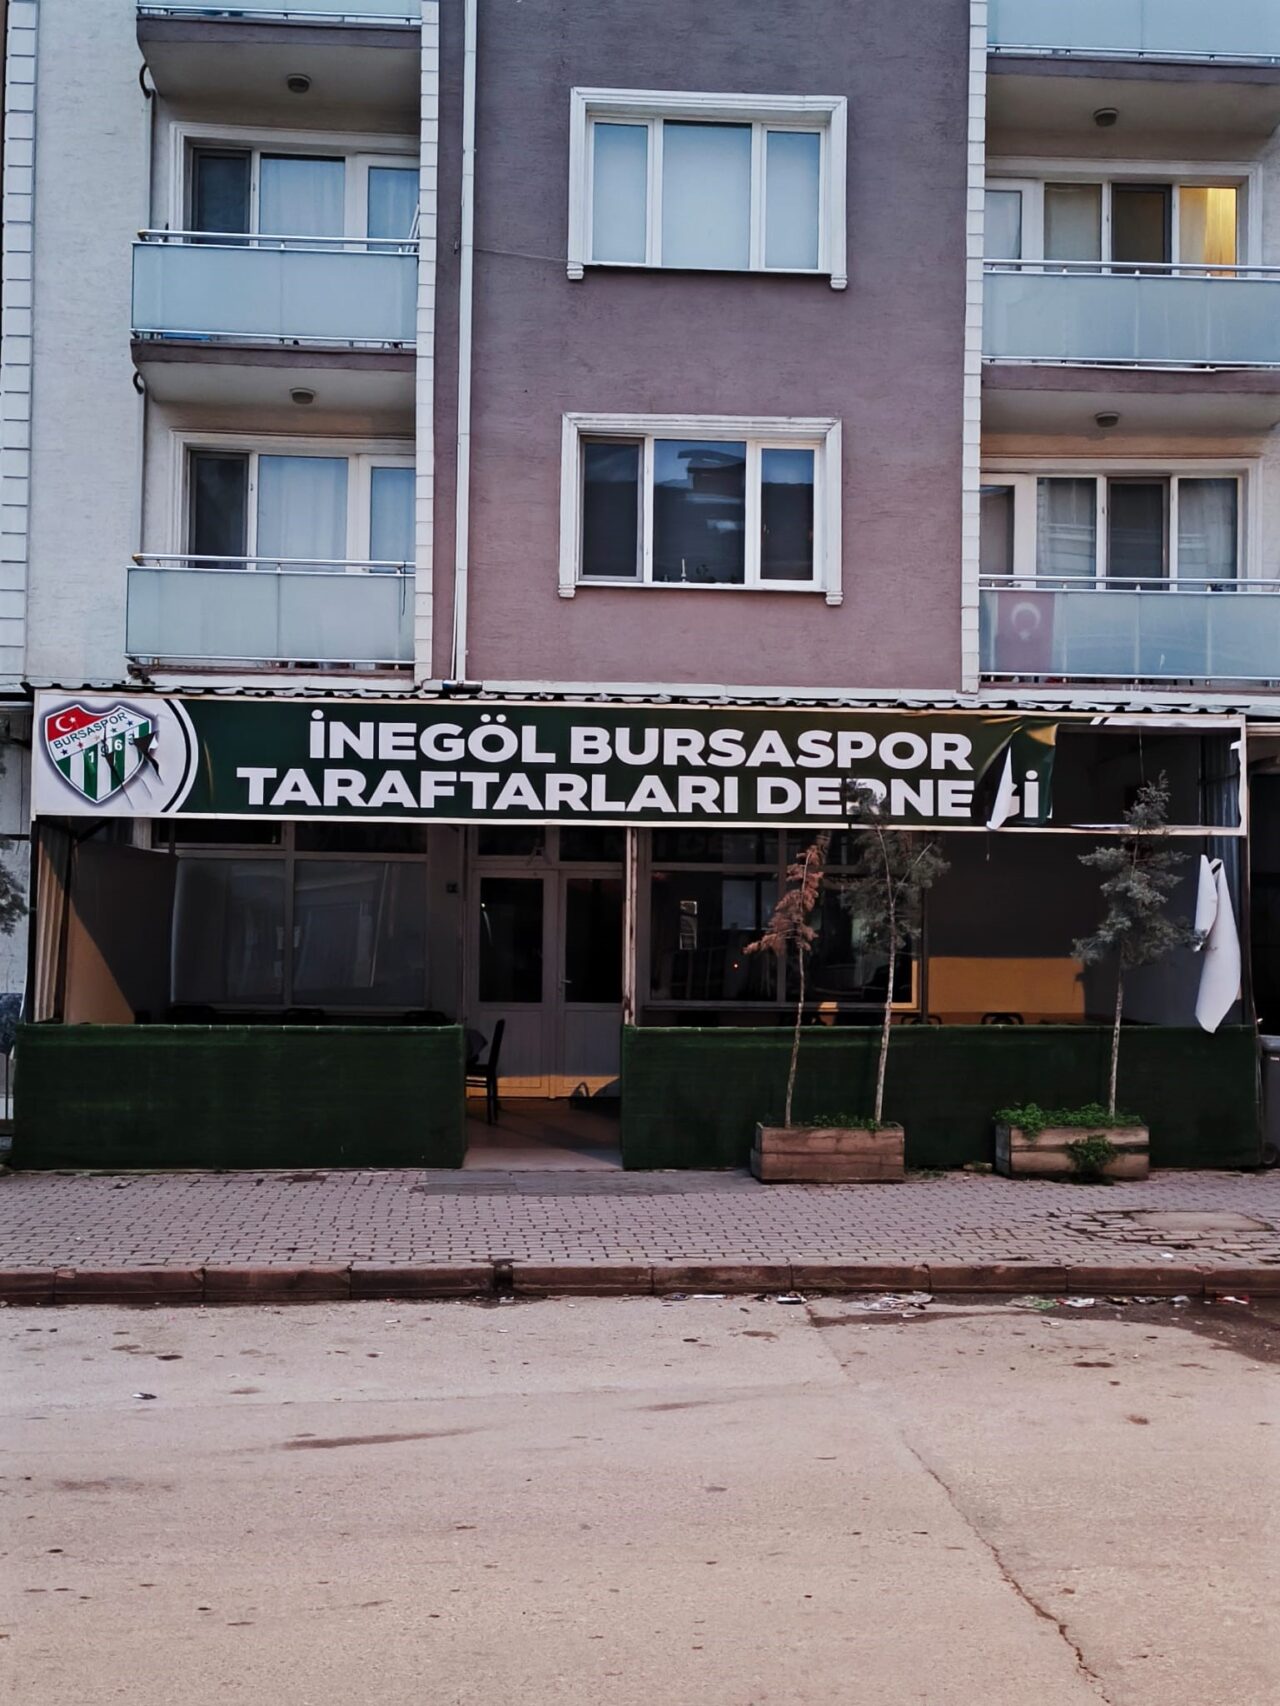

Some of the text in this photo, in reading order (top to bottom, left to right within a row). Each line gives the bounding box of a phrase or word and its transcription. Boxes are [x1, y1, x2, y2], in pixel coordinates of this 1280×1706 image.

[53, 711, 127, 750] BURSASPOR
[309, 709, 974, 770] İNEGÖL BURSASPOR
[237, 767, 738, 813] TARAFTARLARI
